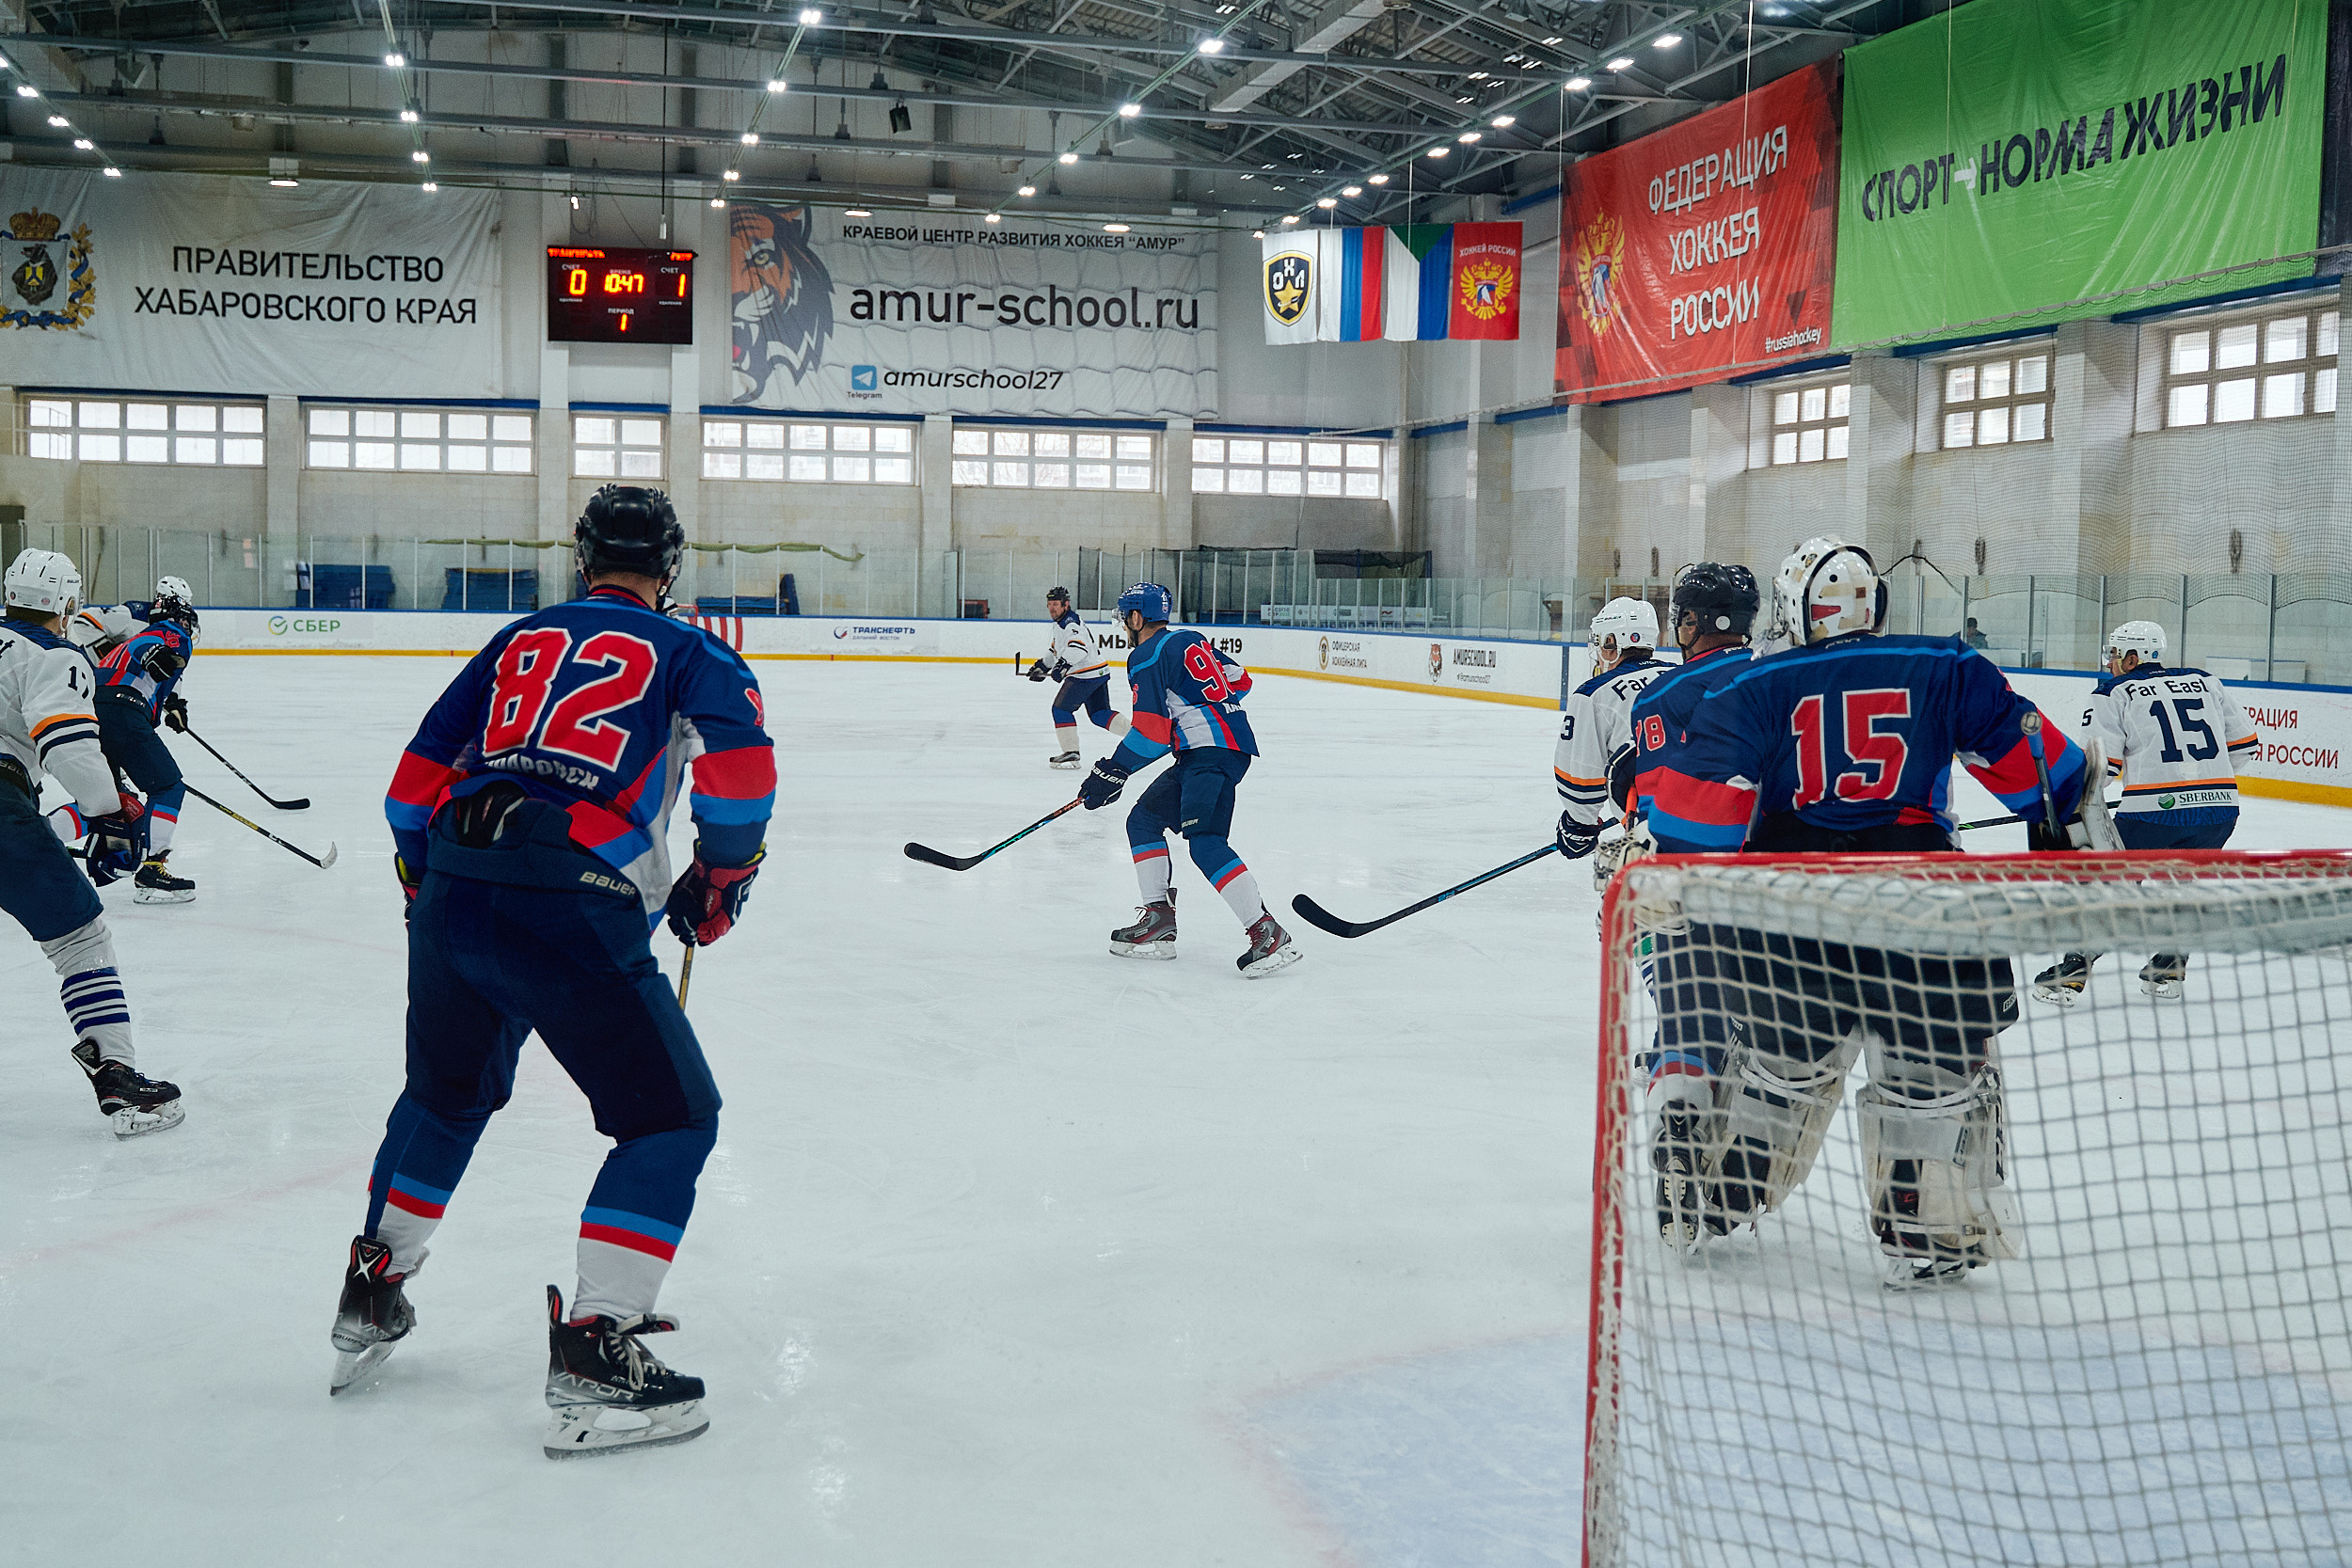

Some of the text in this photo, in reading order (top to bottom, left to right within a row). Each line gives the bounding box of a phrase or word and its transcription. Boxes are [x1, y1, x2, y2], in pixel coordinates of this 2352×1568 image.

[1862, 54, 2286, 222] СПОРТ НОРМА ЖИЗНИ
[1648, 124, 1787, 214] ФЕДЕРАЦИЯ
[843, 225, 918, 242] КРАЕВОЙ
[923, 230, 974, 243] ЦЕНТР
[978, 230, 1060, 246] РАЗВИТИЯ
[1065, 235, 1124, 247] ХОККЕЯ
[1669, 206, 1759, 275] ХОККЕЯ
[173, 245, 444, 282] ПРАВИТЕЛЬСТВО
[1459, 243, 1517, 257] ХОККЕЙ РОССИИ
[569, 269, 687, 297] 0 10:47 1
[135, 287, 477, 325] ХАБАРОВСКОГО КРАЯ
[850, 284, 1199, 329] amur-school.ru
[1670, 276, 1759, 340] РОССИИ
[620, 313, 628, 331] 1
[1765, 326, 1822, 353] #russiahockey
[883, 369, 1063, 390] amurschool27
[294, 620, 341, 632] СБЕР
[1219, 639, 1243, 653] #19
[1453, 648, 1496, 668] AMURSCHOOL.RU
[483, 627, 659, 773] 82
[1611, 676, 1648, 702] Far
[2124, 678, 2209, 701] Far East
[2149, 698, 2219, 763] 15
[1790, 688, 1912, 811] 15
[2267, 744, 2339, 768] РОССИИ
[2179, 791, 2233, 803] SBERBANK
[551, 1369, 638, 1402] VAPOR
